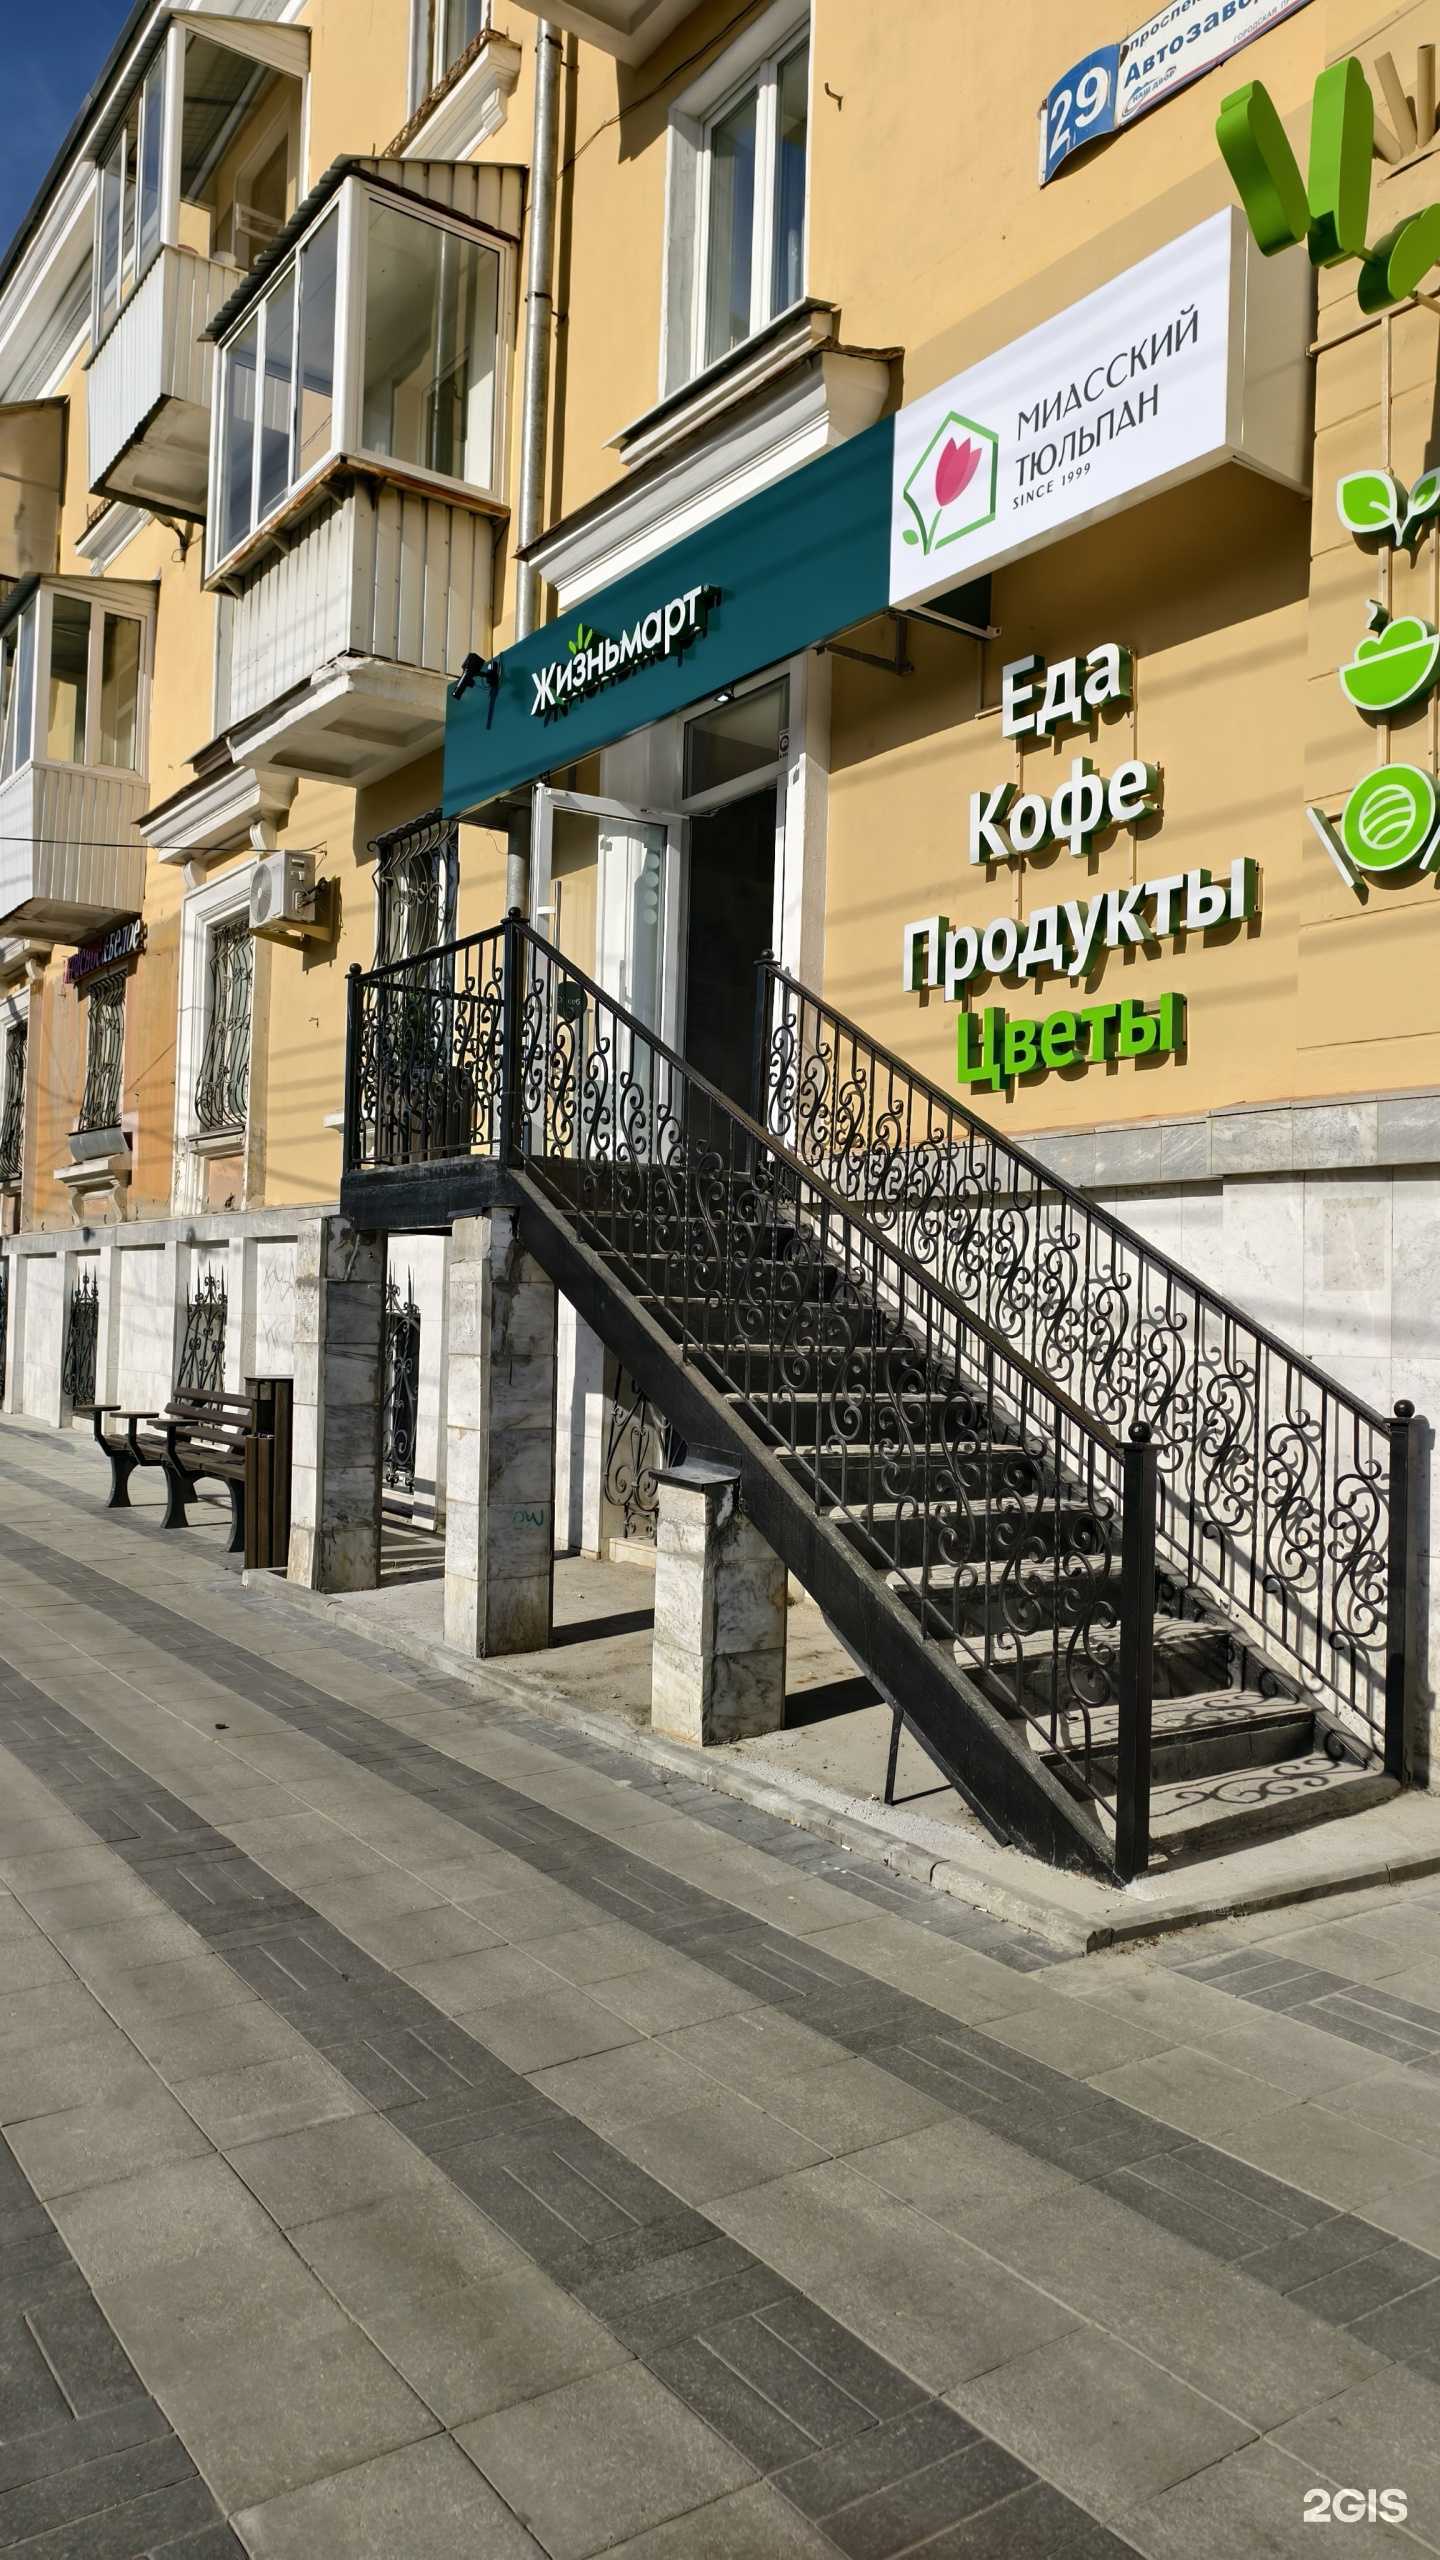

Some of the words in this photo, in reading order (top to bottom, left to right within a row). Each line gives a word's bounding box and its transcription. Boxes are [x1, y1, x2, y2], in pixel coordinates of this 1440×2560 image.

[1124, 0, 1258, 88] Автозаво
[1130, 0, 1200, 51] проспе
[1049, 66, 1109, 160] 29
[1018, 304, 1198, 441] МИАССКИЙ
[1016, 383, 1159, 486] ТЮЛЬПАН
[1012, 480, 1054, 510] SINCE
[1062, 462, 1091, 487] 1999
[531, 585, 702, 715] Жизньмарт
[1002, 642, 1131, 739] Еда
[969, 756, 1151, 865] Кофе
[903, 857, 1252, 1002] Продукты
[957, 993, 1183, 1091] Цветы
